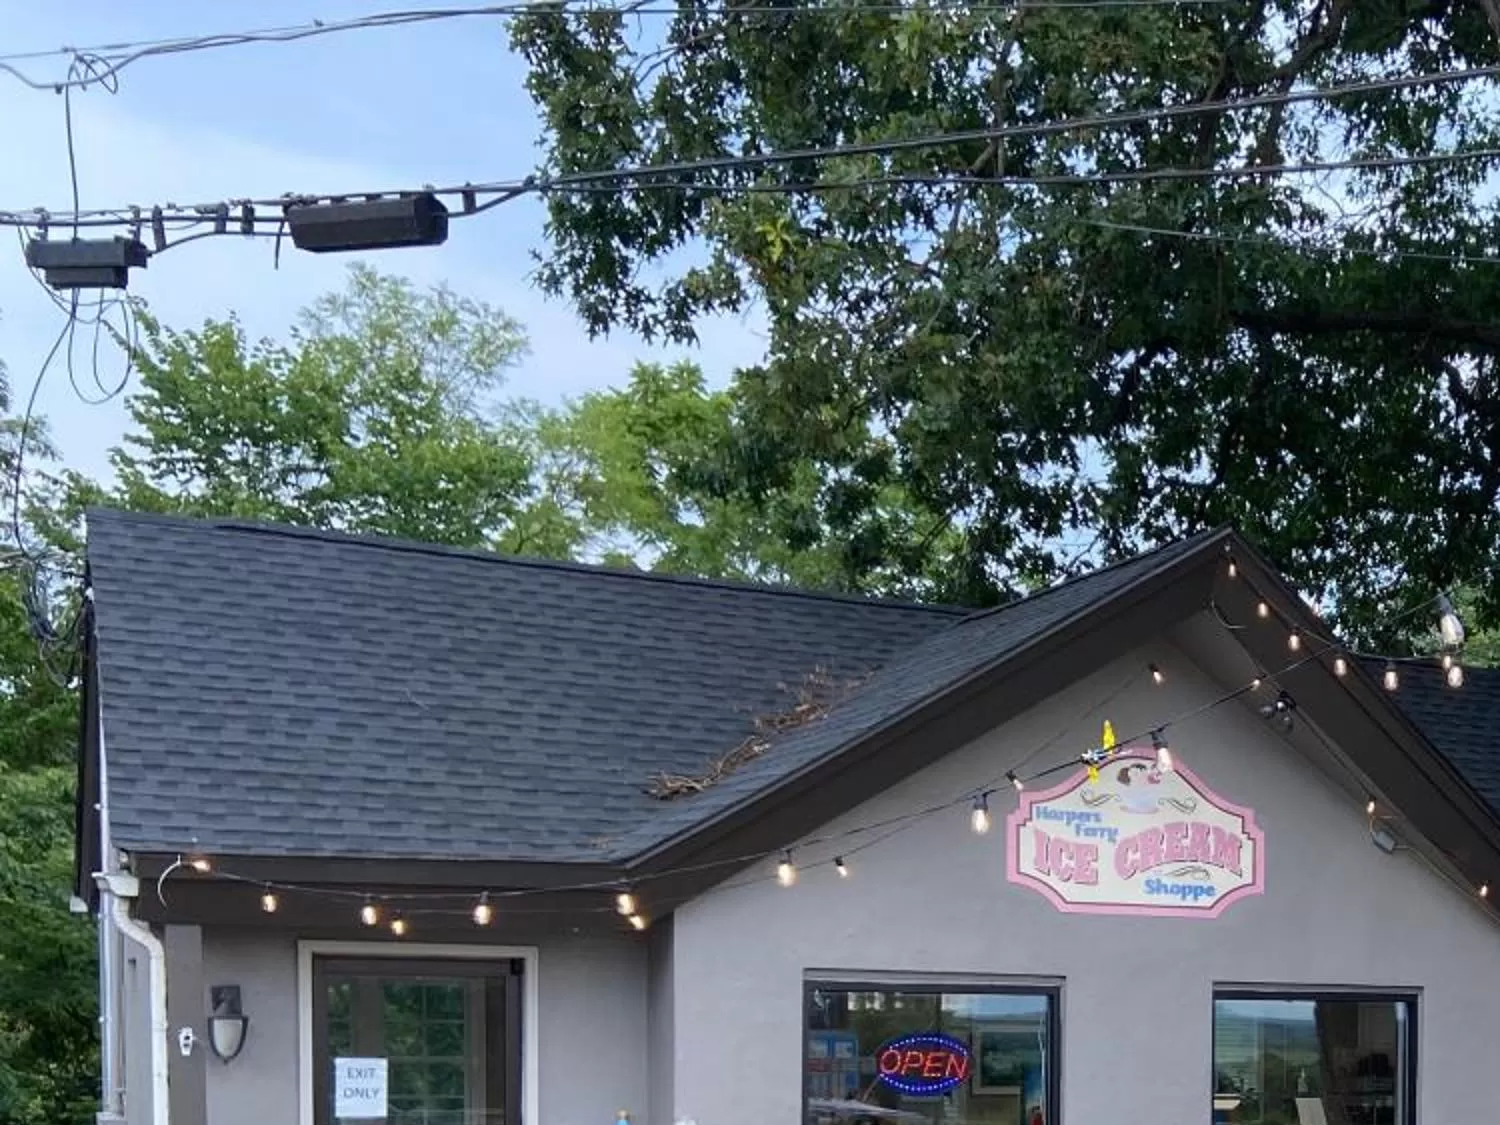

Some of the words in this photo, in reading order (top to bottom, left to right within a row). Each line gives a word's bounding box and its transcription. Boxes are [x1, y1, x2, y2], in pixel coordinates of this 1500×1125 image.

[1035, 805, 1101, 825] Harpers
[1075, 823, 1119, 843] Ferry
[1034, 829, 1099, 884] ICE
[1114, 821, 1243, 880] CREAM
[1144, 878, 1217, 900] Shoppe
[347, 1067, 376, 1079] EXIT
[880, 1048, 968, 1078] OPEN
[343, 1087, 380, 1099] ONLY
